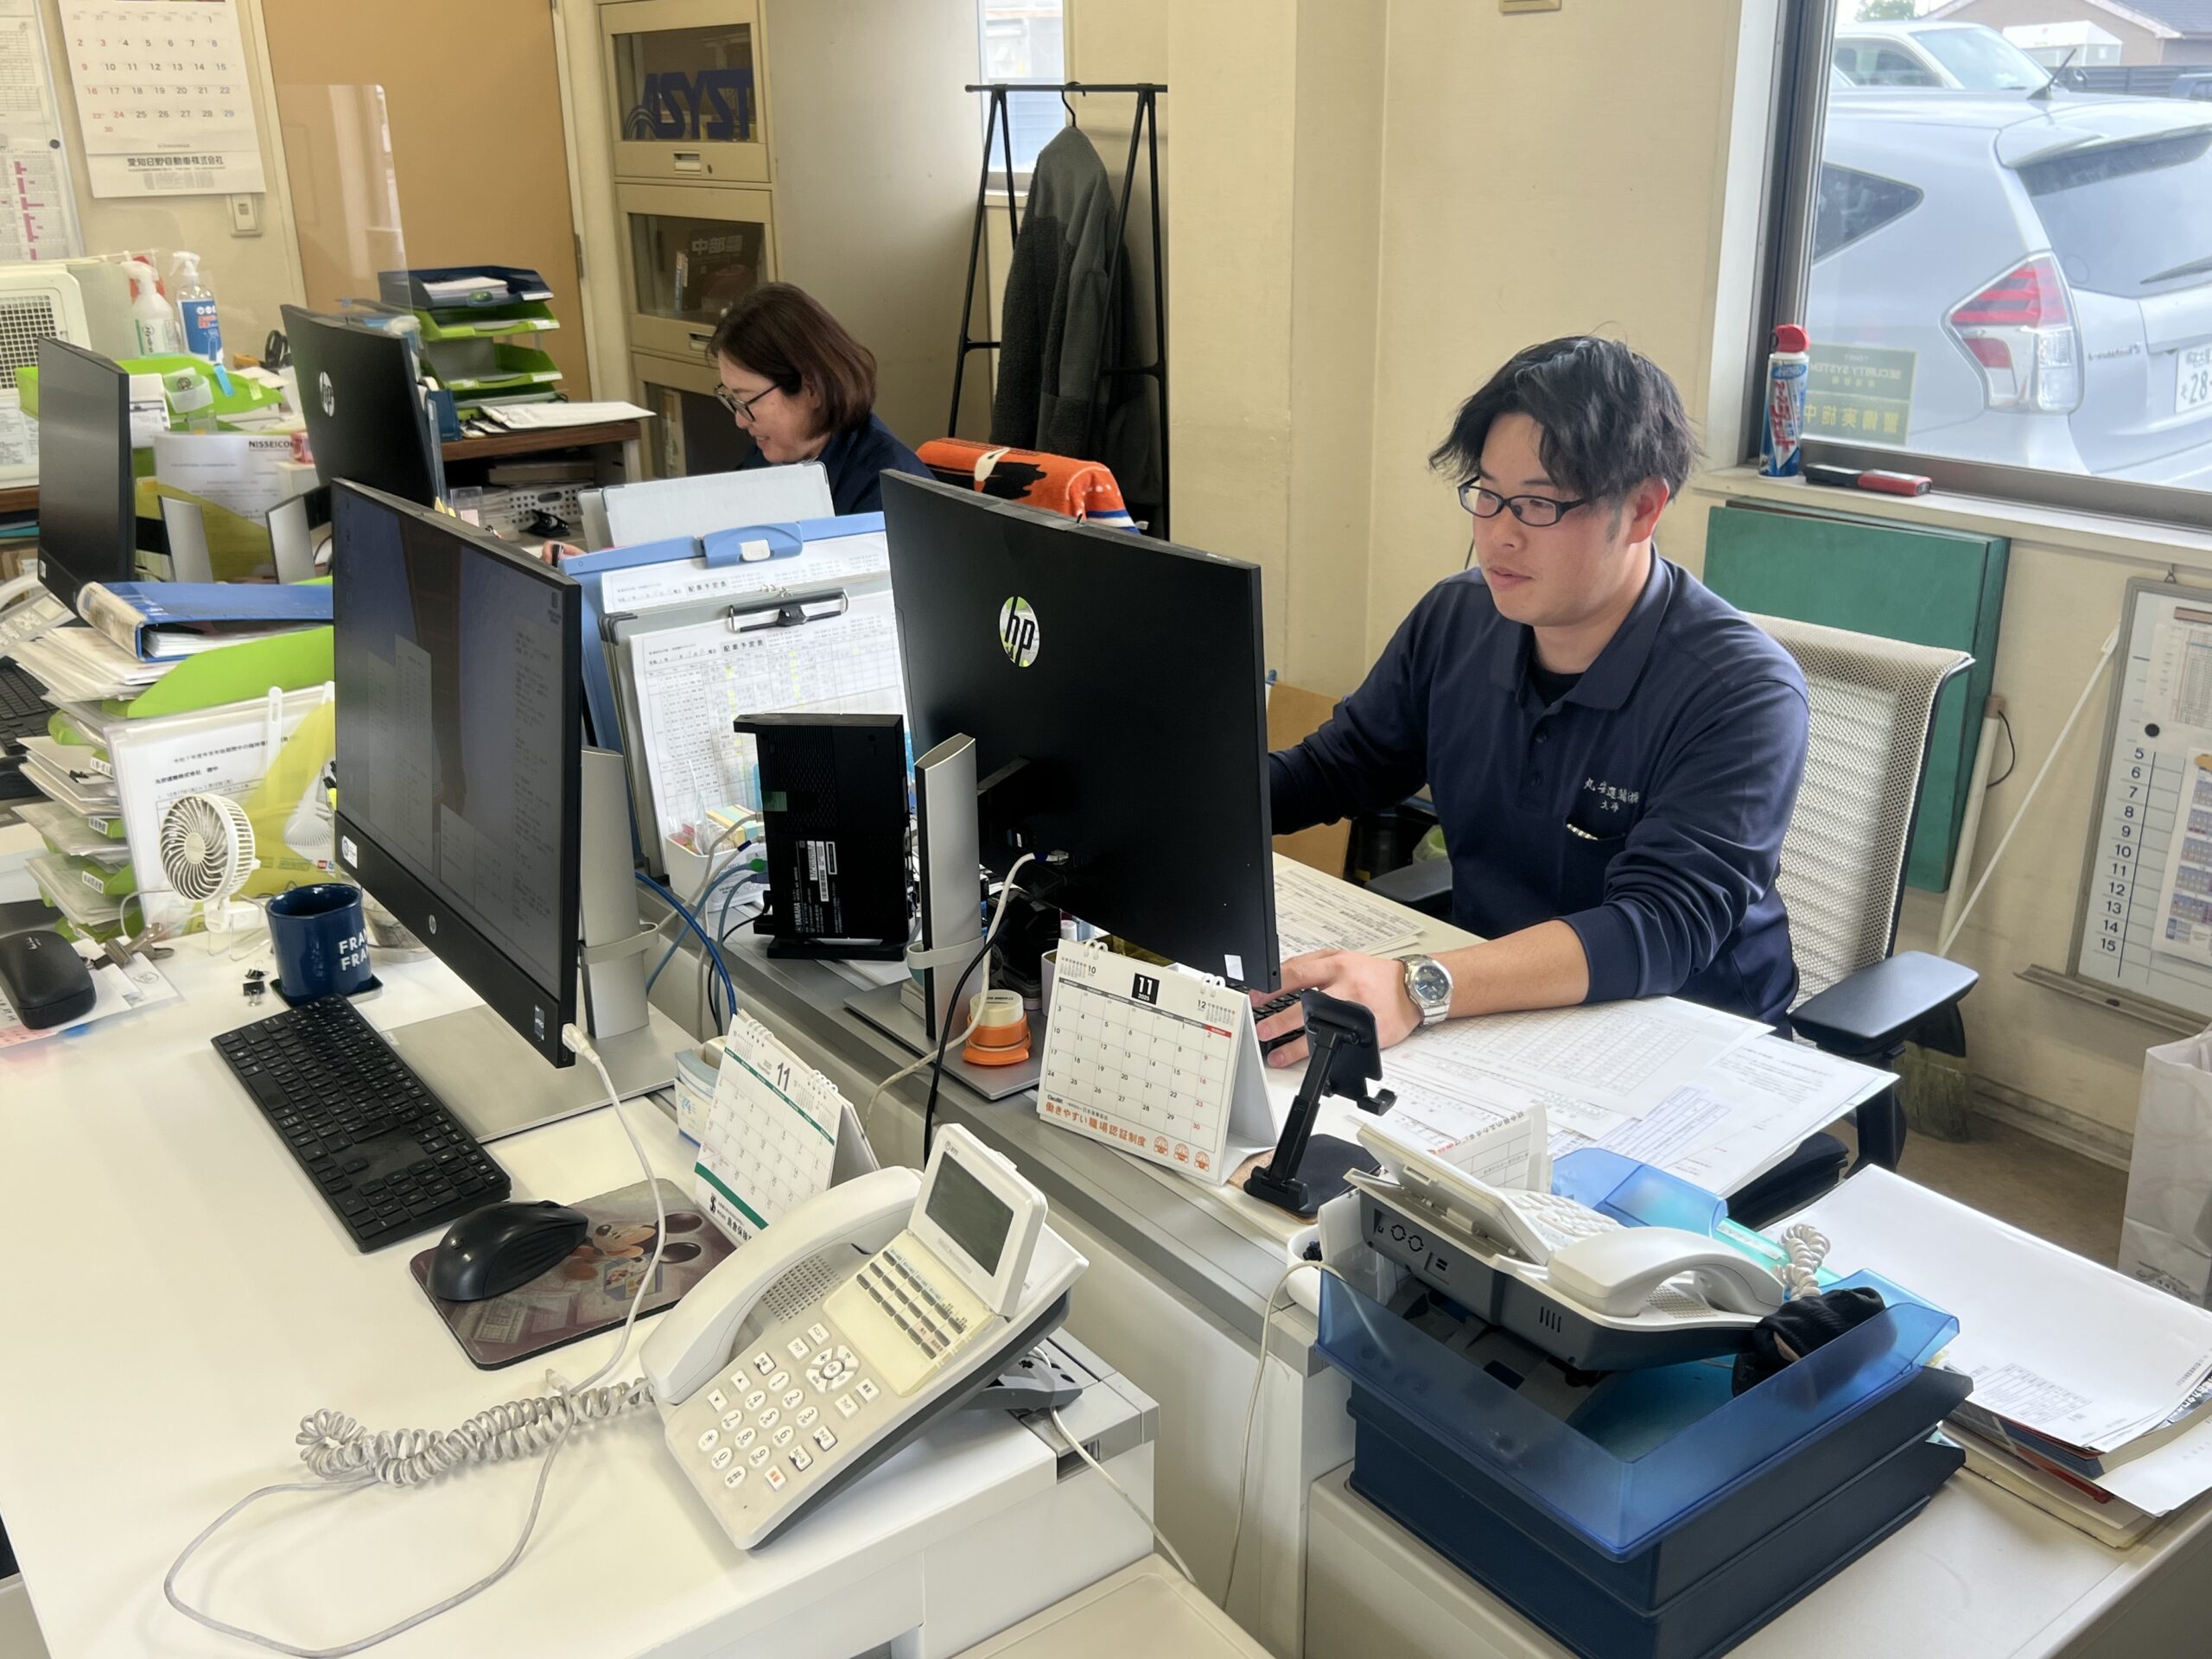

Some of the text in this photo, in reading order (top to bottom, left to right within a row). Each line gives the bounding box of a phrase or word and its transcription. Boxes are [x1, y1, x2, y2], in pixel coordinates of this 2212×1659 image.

[212, 39, 218, 48] 8
[1003, 595, 1037, 667] hp
[2134, 747, 2145, 760] 5
[2131, 766, 2141, 779] 6
[2129, 786, 2139, 798] 7
[2124, 805, 2134, 818] 8
[2121, 825, 2131, 837] 9
[2114, 844, 2132, 858] 10
[2112, 863, 2126, 876] 11
[2108, 882, 2125, 896] 12
[2106, 900, 2121, 914] 13
[2103, 919, 2118, 933] 14
[2101, 938, 2116, 951] 15
[1088, 965, 1096, 974] 10
[1139, 977, 1153, 995] 11
[1198, 1000, 1207, 1008] 12
[777, 1062, 791, 1092] 11
[1046, 1101, 1147, 1147] 働きやすい職場認証制度
